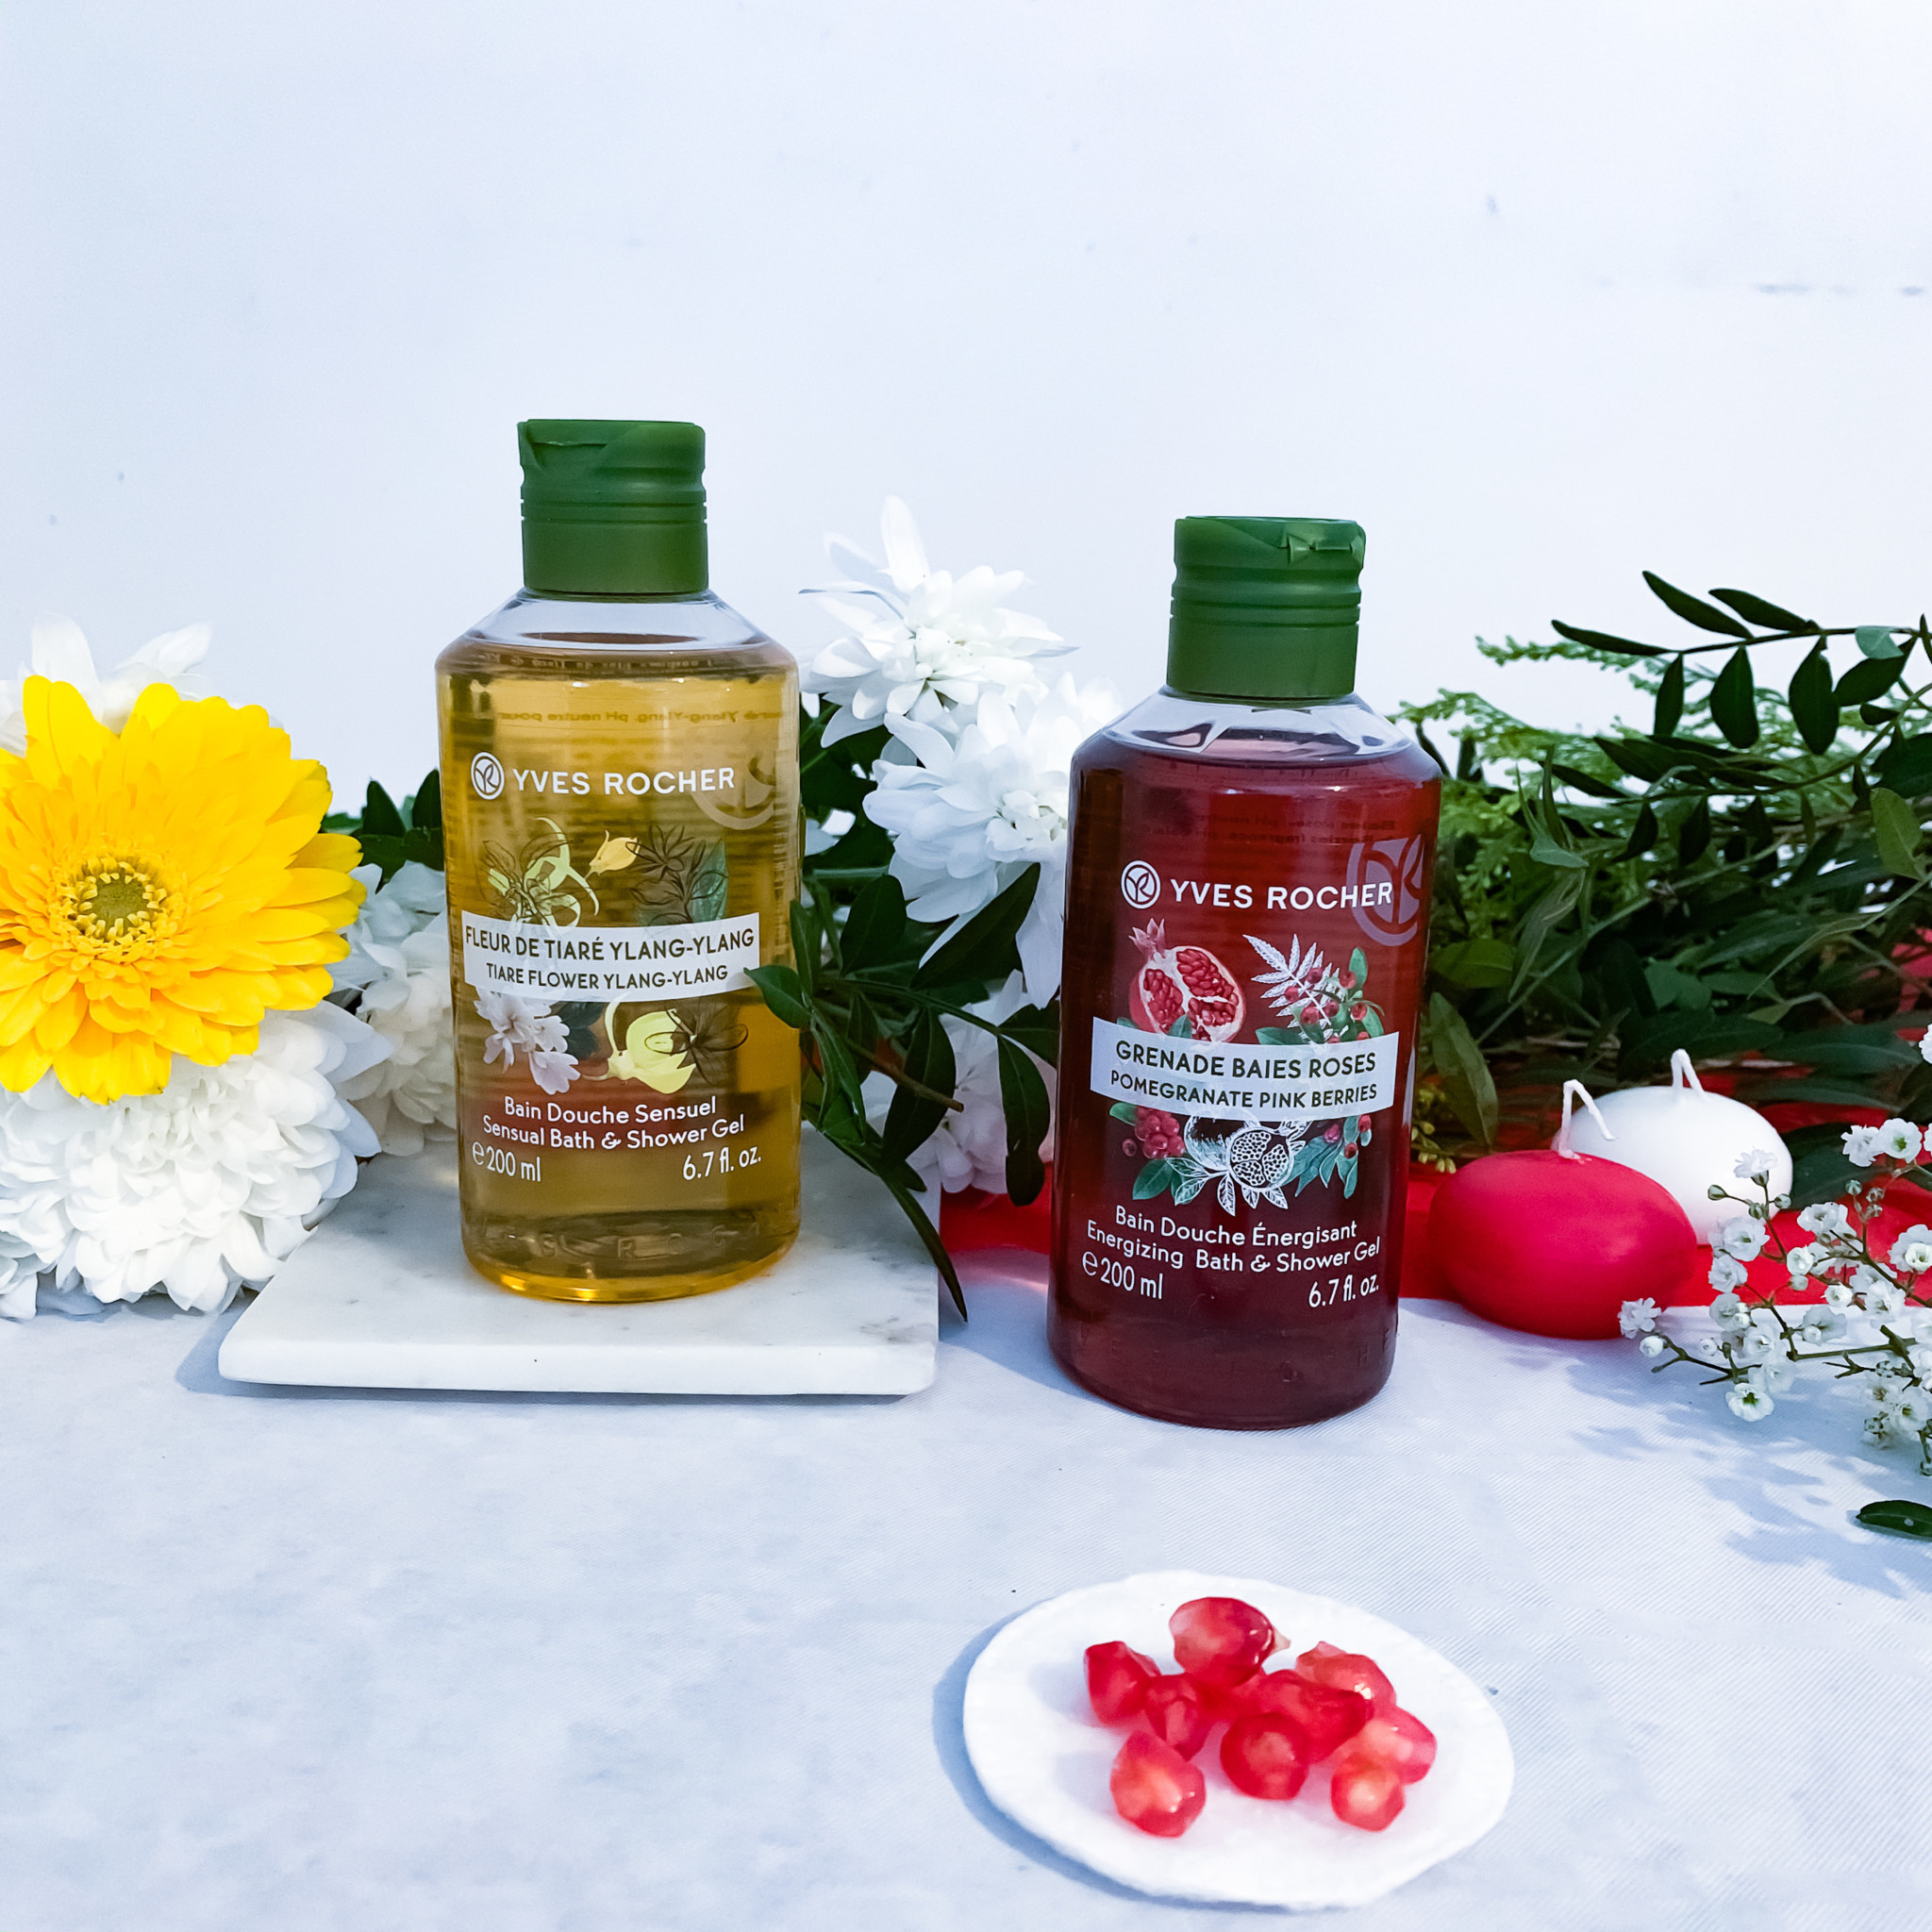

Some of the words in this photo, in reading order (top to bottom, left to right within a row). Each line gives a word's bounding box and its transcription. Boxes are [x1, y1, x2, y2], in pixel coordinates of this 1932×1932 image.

[512, 768, 591, 795] YVES
[604, 767, 735, 796] ROCHER
[1170, 878, 1254, 909] YVES
[1267, 881, 1393, 910] ROCHER
[465, 925, 511, 955] FLEUR
[515, 938, 540, 958] DE
[543, 936, 604, 960] TIARÉ
[609, 928, 755, 961] YLANG-YLANG
[486, 962, 525, 984] TIARE
[528, 970, 599, 990] FLOWER
[604, 964, 728, 990] YLANG-YLANG
[1116, 1040, 1225, 1076] GRENADE
[1231, 1058, 1302, 1079] BAIES
[1308, 1052, 1376, 1078] ROSES
[1111, 1069, 1254, 1108] POMEGRANATE
[1259, 1091, 1307, 1108] PINK
[1311, 1084, 1377, 1108] BERRIES
[505, 1095, 541, 1121] Bain
[547, 1103, 629, 1124] Douche
[635, 1095, 717, 1123] Sensuel
[483, 1114, 544, 1145] Sensual
[550, 1127, 595, 1149] Bath
[601, 1132, 622, 1150] &
[626, 1126, 708, 1149] Shower
[711, 1114, 745, 1139] Gel
[521, 1156, 541, 1182] ml
[682, 1152, 713, 1180] 6.7
[739, 1146, 762, 1168] oz.
[1116, 1205, 1155, 1233] Bain
[1160, 1217, 1245, 1246] Douche
[1252, 1220, 1357, 1250] Énergisant
[1087, 1219, 1184, 1269] Energizing
[1195, 1249, 1243, 1272] Bath
[1250, 1253, 1271, 1273] &
[1275, 1249, 1351, 1274] Shower
[1354, 1236, 1381, 1261] Gel
[1140, 1273, 1163, 1300] ml
[1307, 1278, 1339, 1307] 6.7
[1359, 1274, 1380, 1295] oz.
